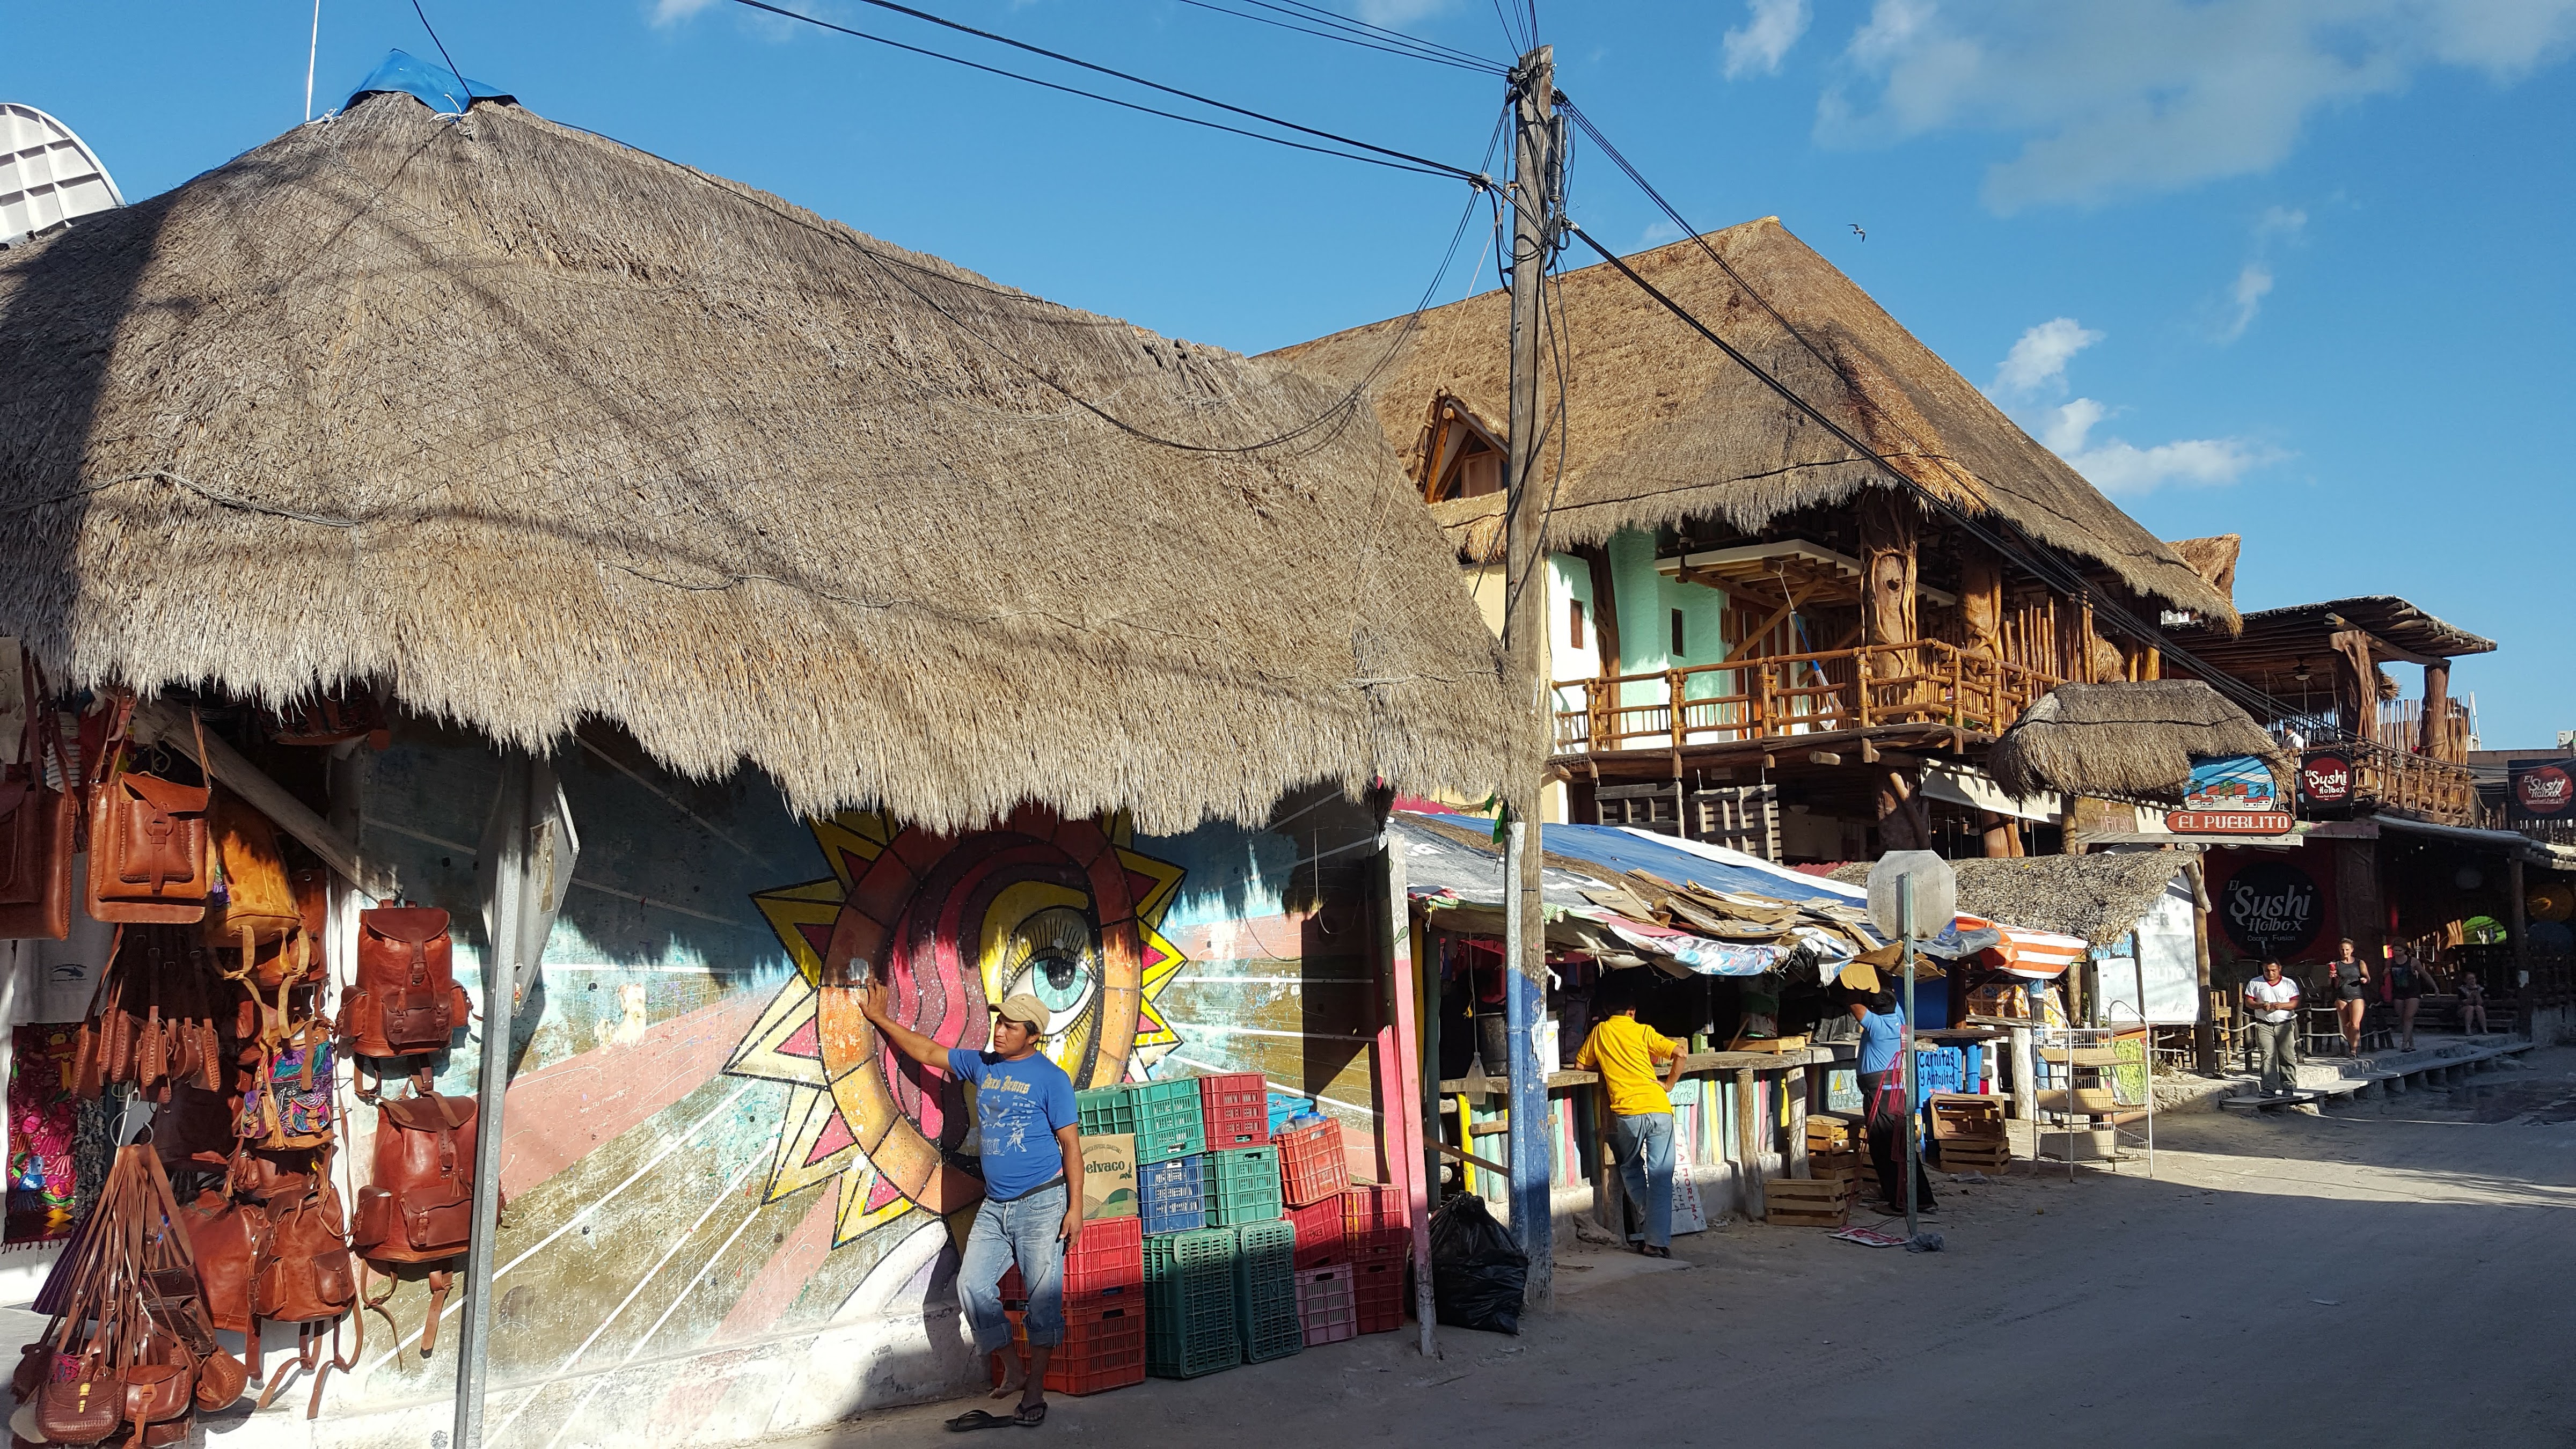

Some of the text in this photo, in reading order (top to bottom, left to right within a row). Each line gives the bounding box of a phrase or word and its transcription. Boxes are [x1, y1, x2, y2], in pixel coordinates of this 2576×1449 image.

[2309, 769, 2347, 789] Sushi
[2523, 775, 2566, 794] El Sushi
[2318, 786, 2346, 794] Holbox
[2530, 790, 2562, 799] Holbox
[2178, 815, 2289, 829] EL PUEBLITO
[2228, 880, 2314, 926] El Sushi
[2246, 917, 2303, 934] Holbox
[1919, 1049, 1954, 1068] Carnitas
[1927, 1069, 1955, 1086] Antojitos
[1084, 1160, 1125, 1174] elvaco
